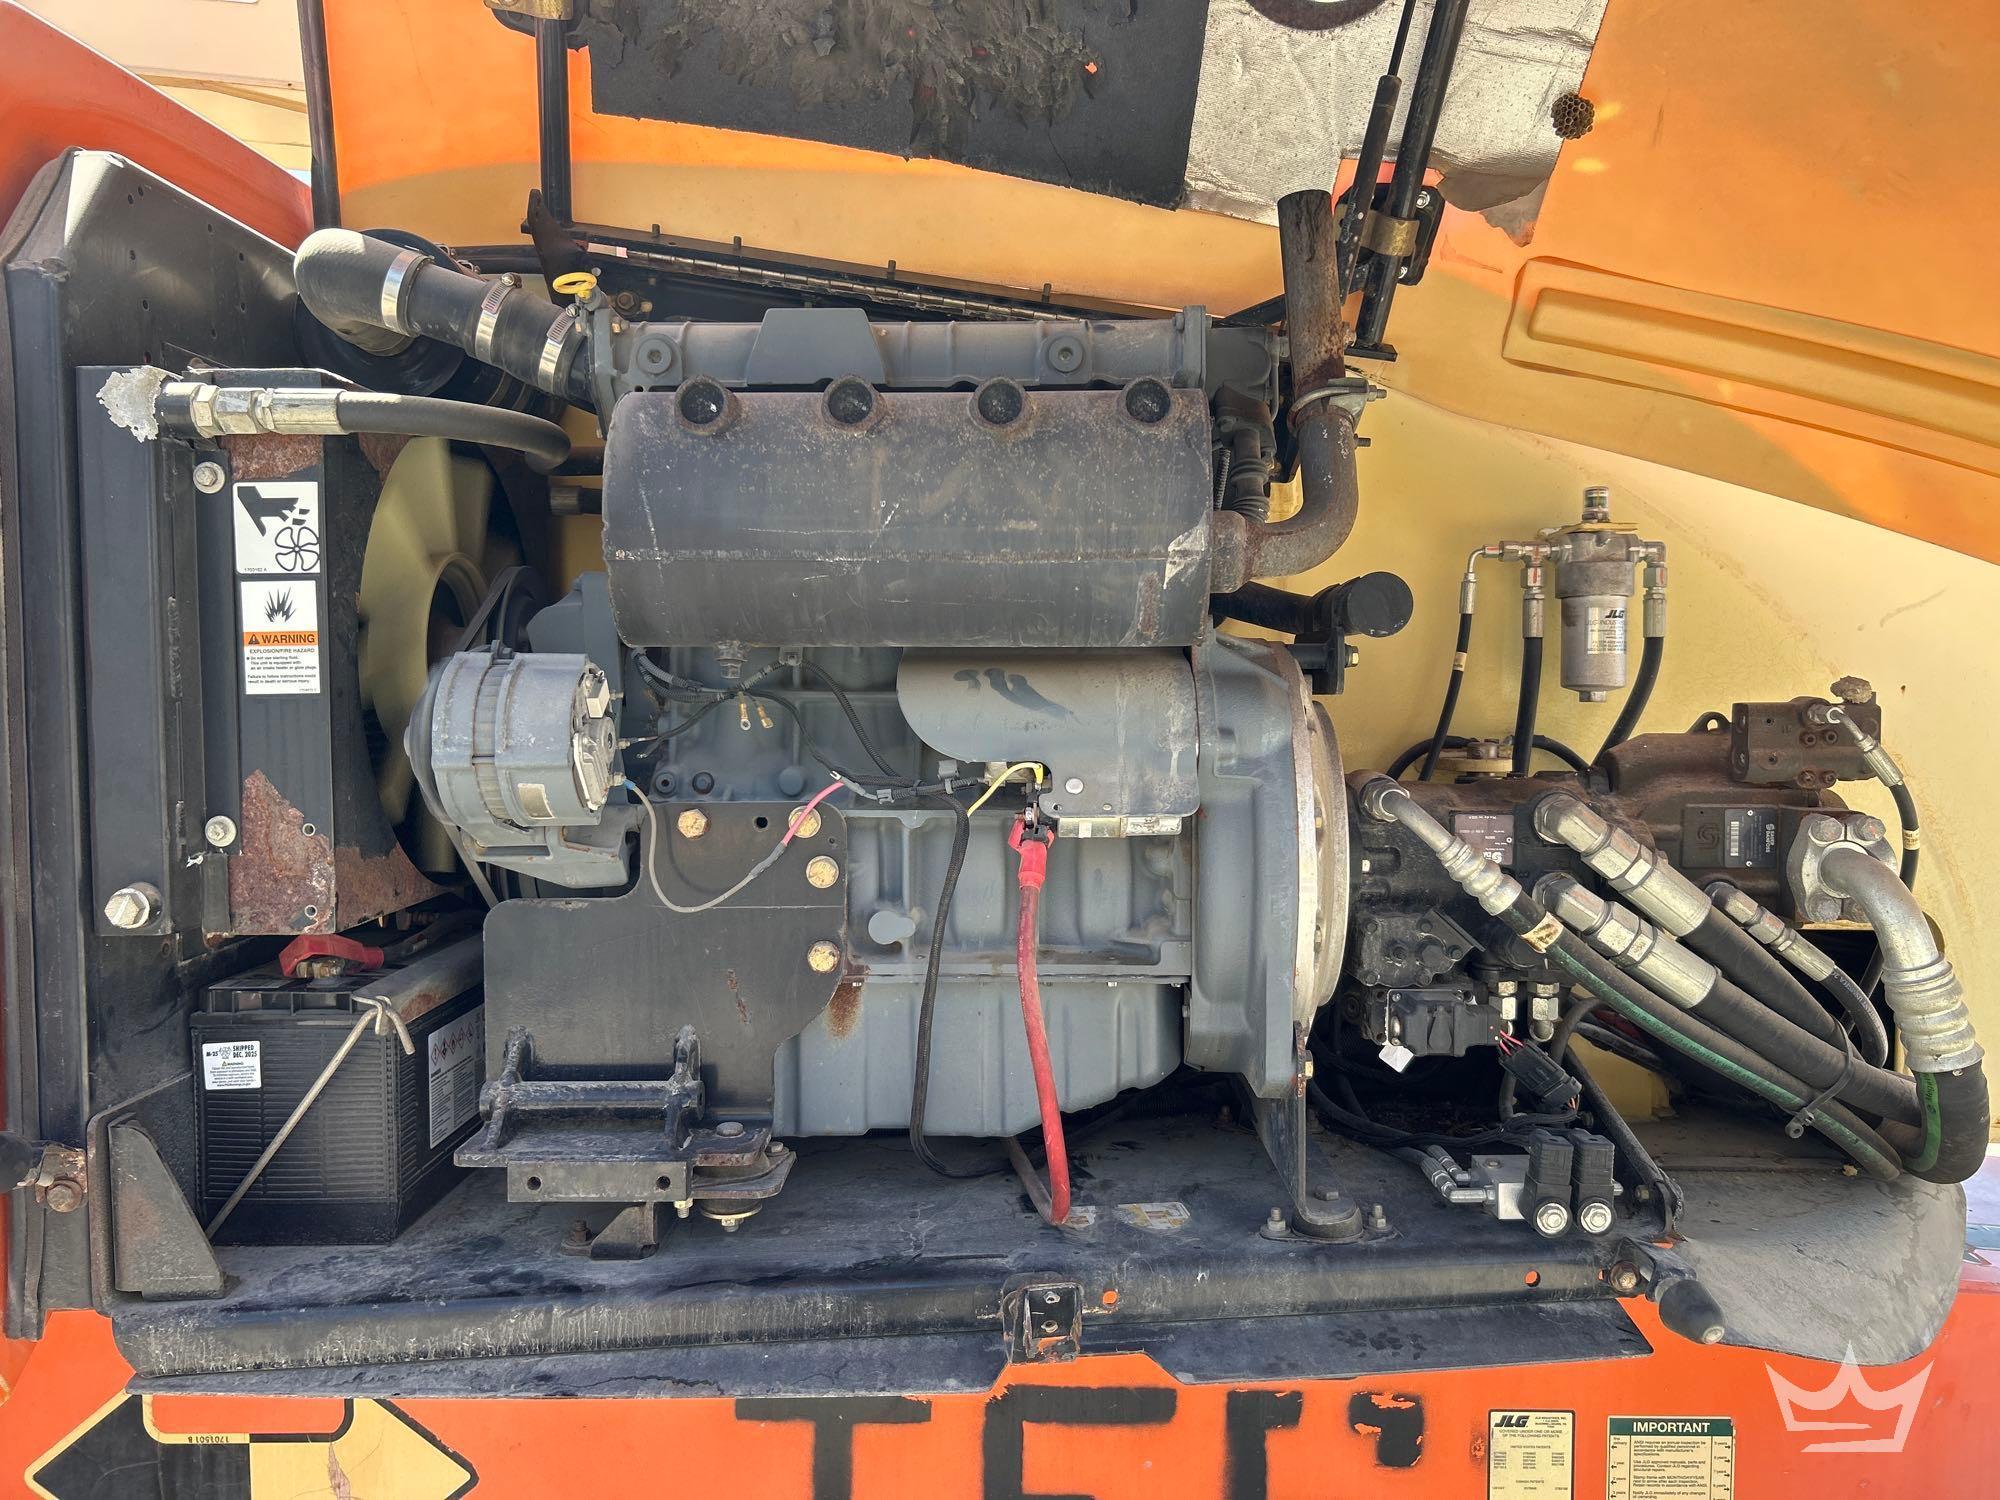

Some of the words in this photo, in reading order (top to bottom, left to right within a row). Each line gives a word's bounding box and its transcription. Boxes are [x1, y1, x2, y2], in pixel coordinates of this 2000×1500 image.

[1605, 610, 1624, 618] JLG
[262, 634, 315, 643] WARNING
[1494, 1415, 1530, 1427] JLG
[1633, 1422, 1710, 1432] IMPORTANT
